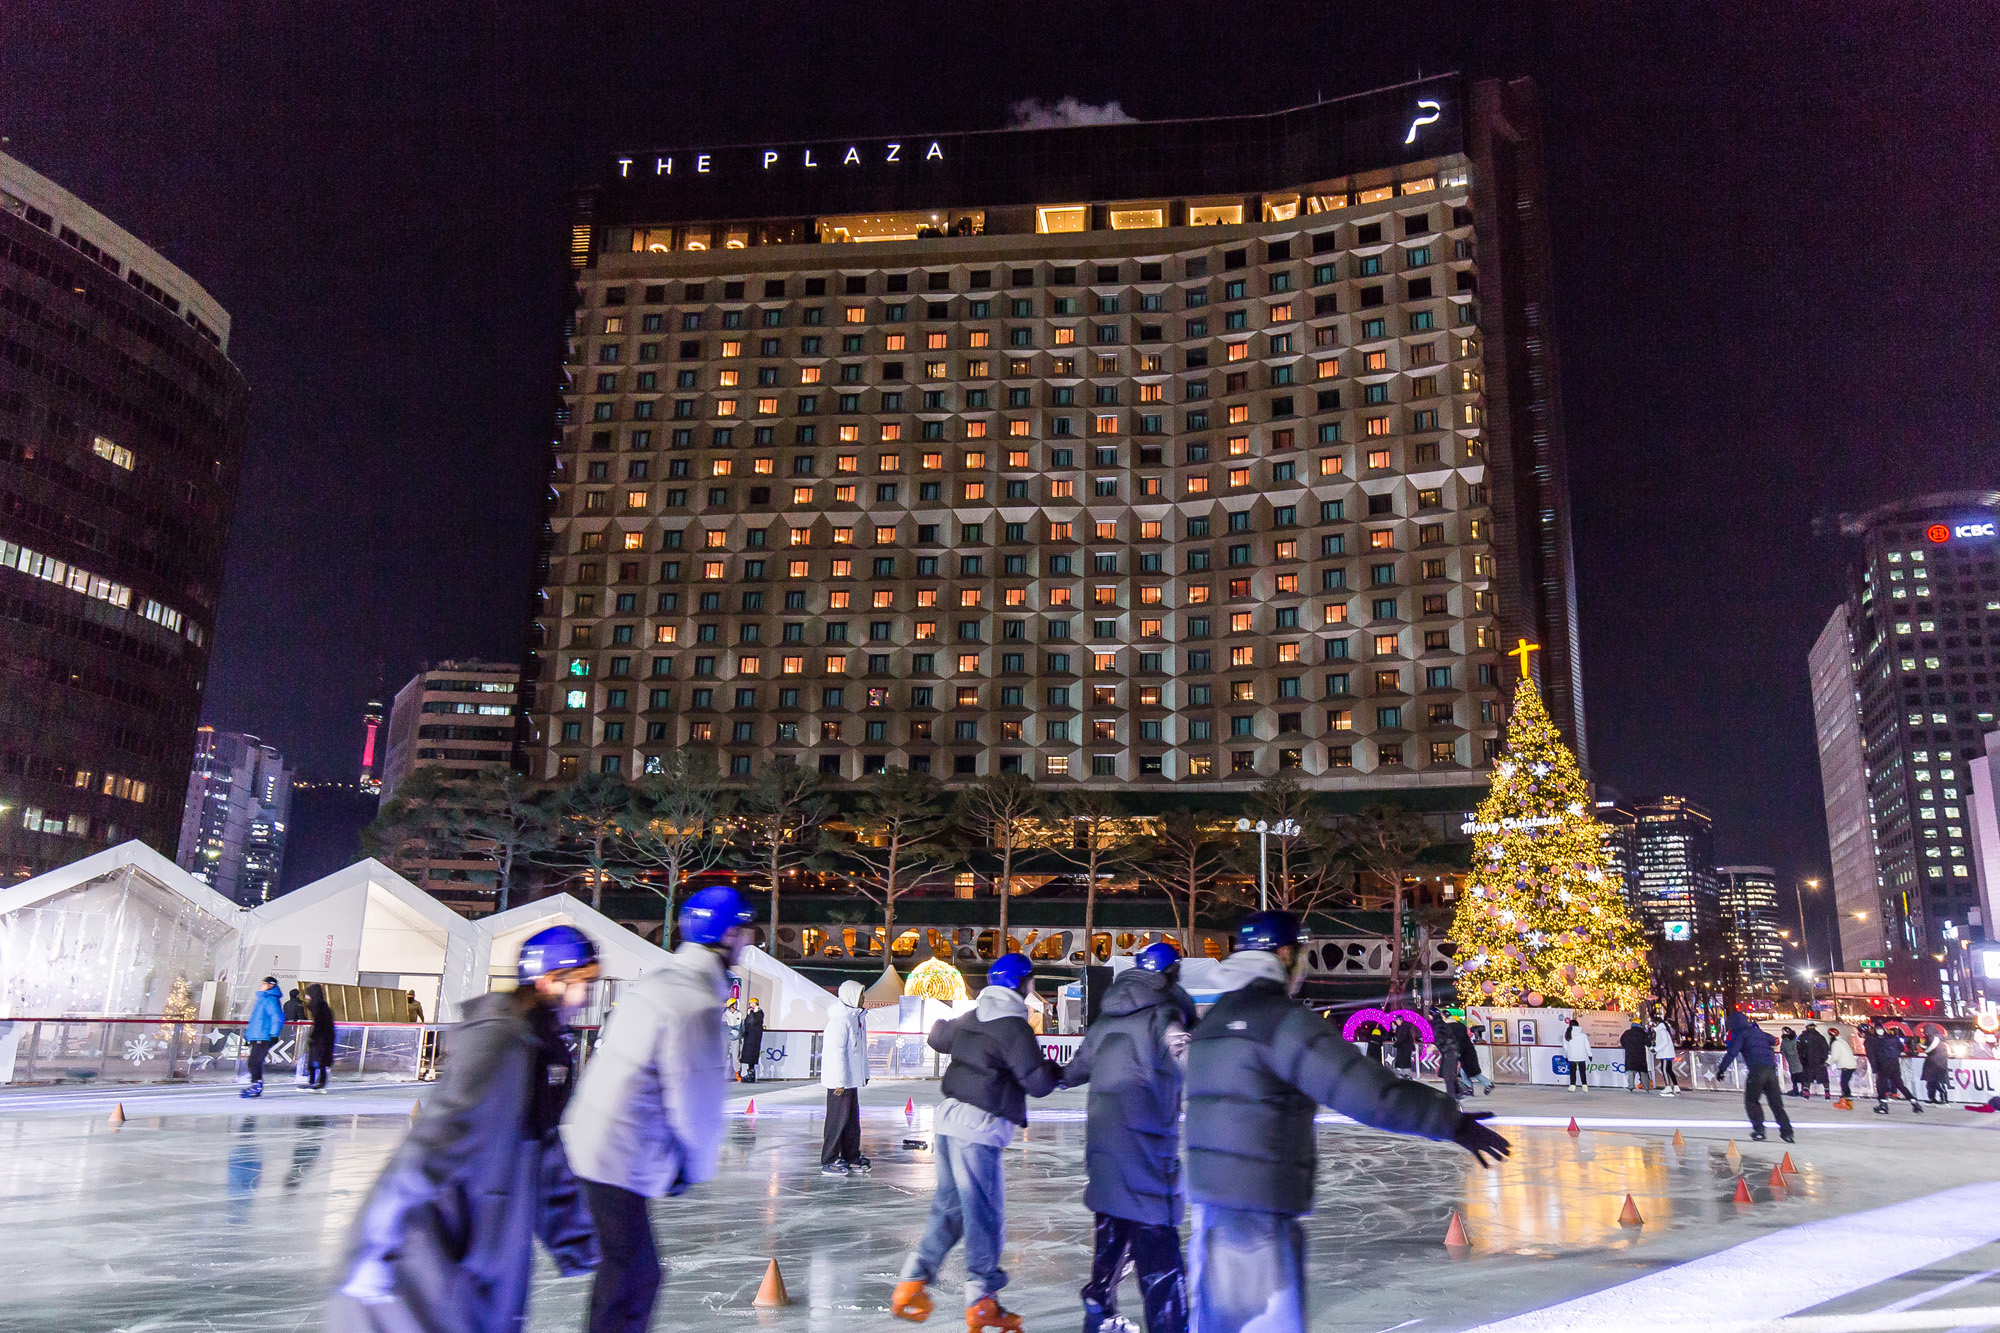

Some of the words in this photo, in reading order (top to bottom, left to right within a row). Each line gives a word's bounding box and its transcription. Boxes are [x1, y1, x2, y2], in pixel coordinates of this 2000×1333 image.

[619, 155, 710, 177] THE
[764, 142, 942, 168] PLAZA
[1955, 523, 1994, 537] ICBC
[1461, 820, 1501, 835] Merry
[1502, 815, 1562, 829] Christmas
[766, 1045, 788, 1061] SOL
